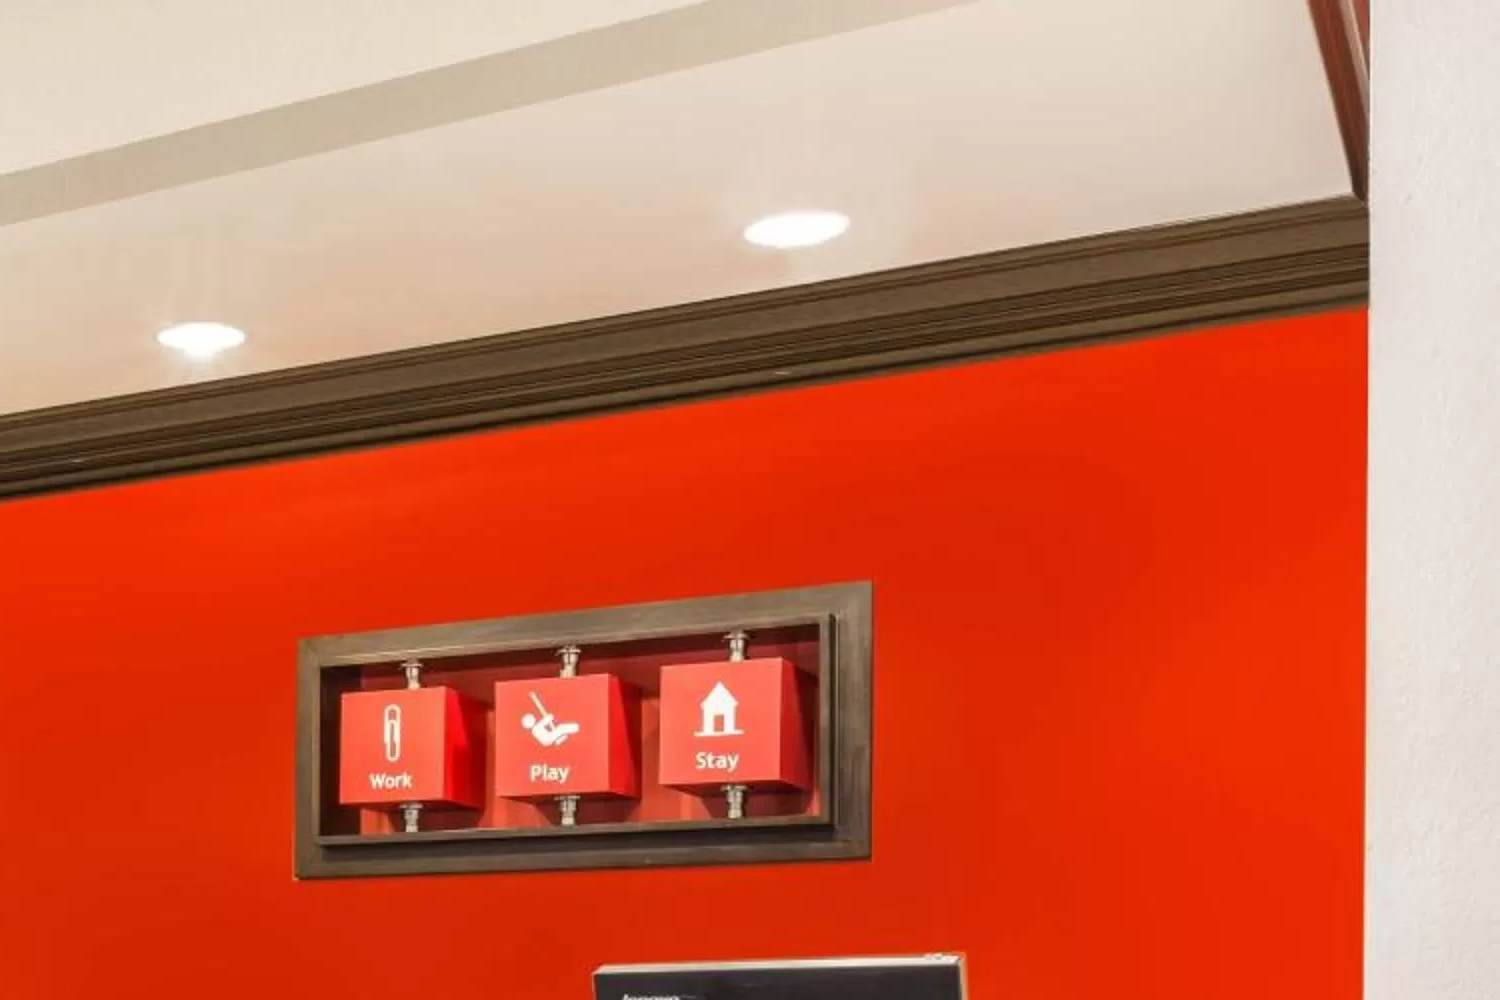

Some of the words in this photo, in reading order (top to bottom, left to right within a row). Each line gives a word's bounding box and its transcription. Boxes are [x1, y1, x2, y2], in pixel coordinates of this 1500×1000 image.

[695, 752, 739, 771] Stay
[369, 772, 412, 790] Work
[530, 763, 569, 784] Play
